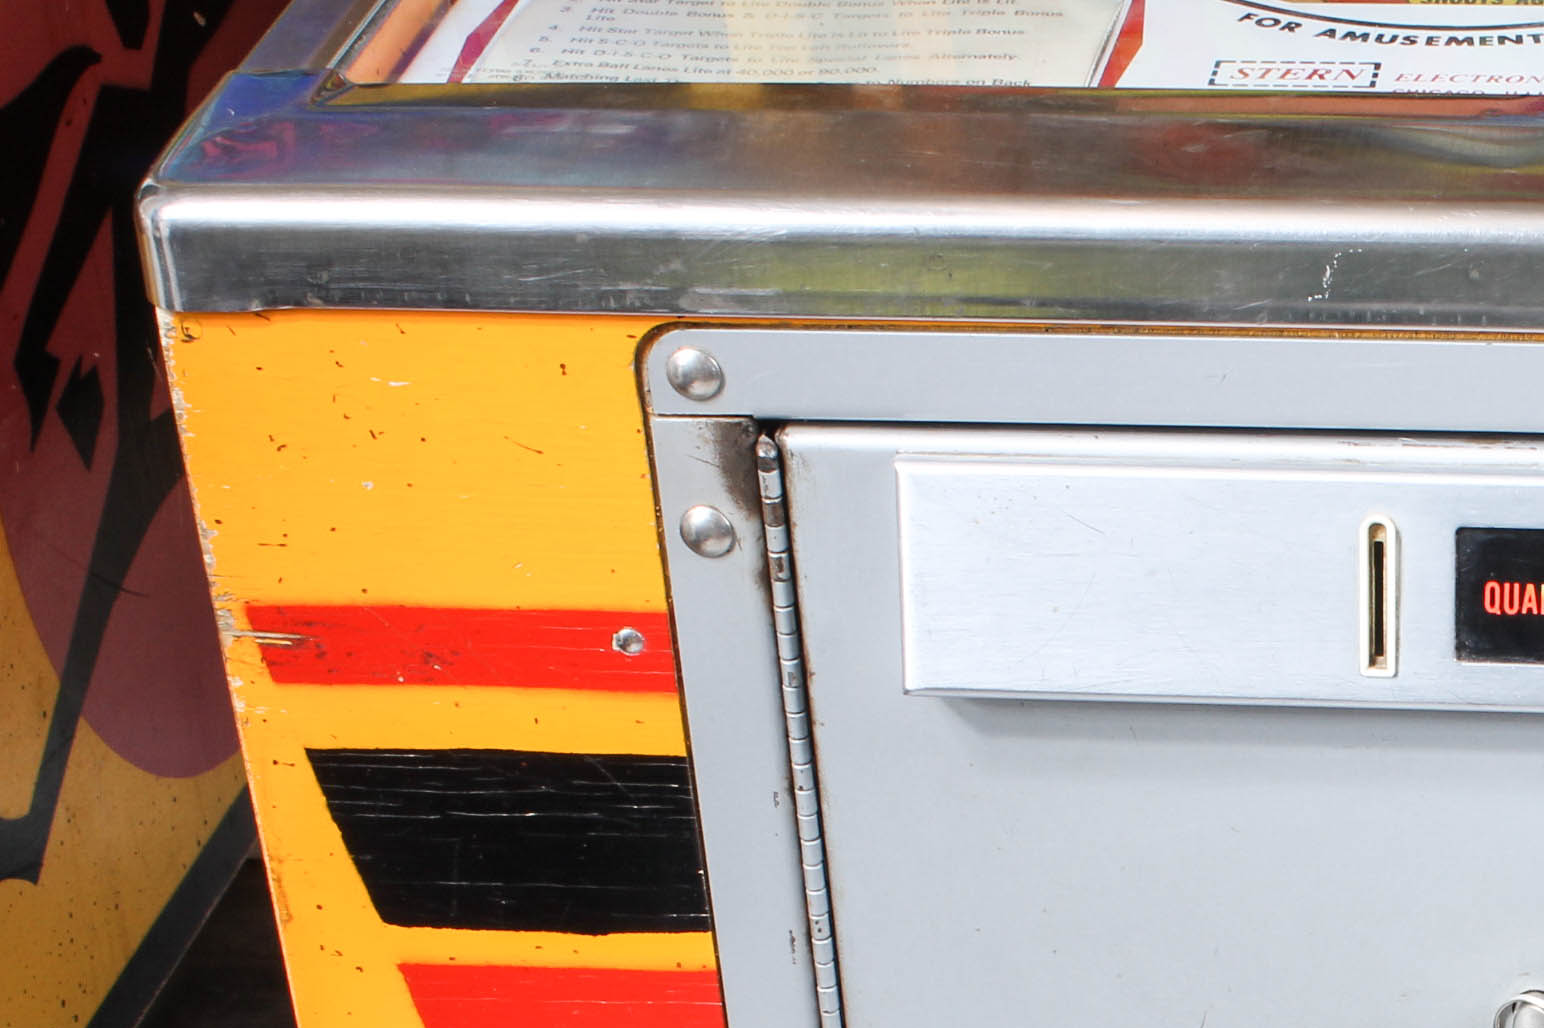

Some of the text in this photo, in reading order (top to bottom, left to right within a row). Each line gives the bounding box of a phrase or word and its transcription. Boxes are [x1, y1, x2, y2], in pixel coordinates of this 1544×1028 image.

[1238, 12, 1303, 33] FOR
[1315, 28, 1544, 48] AMUSEMENT
[1230, 66, 1366, 82] STERN
